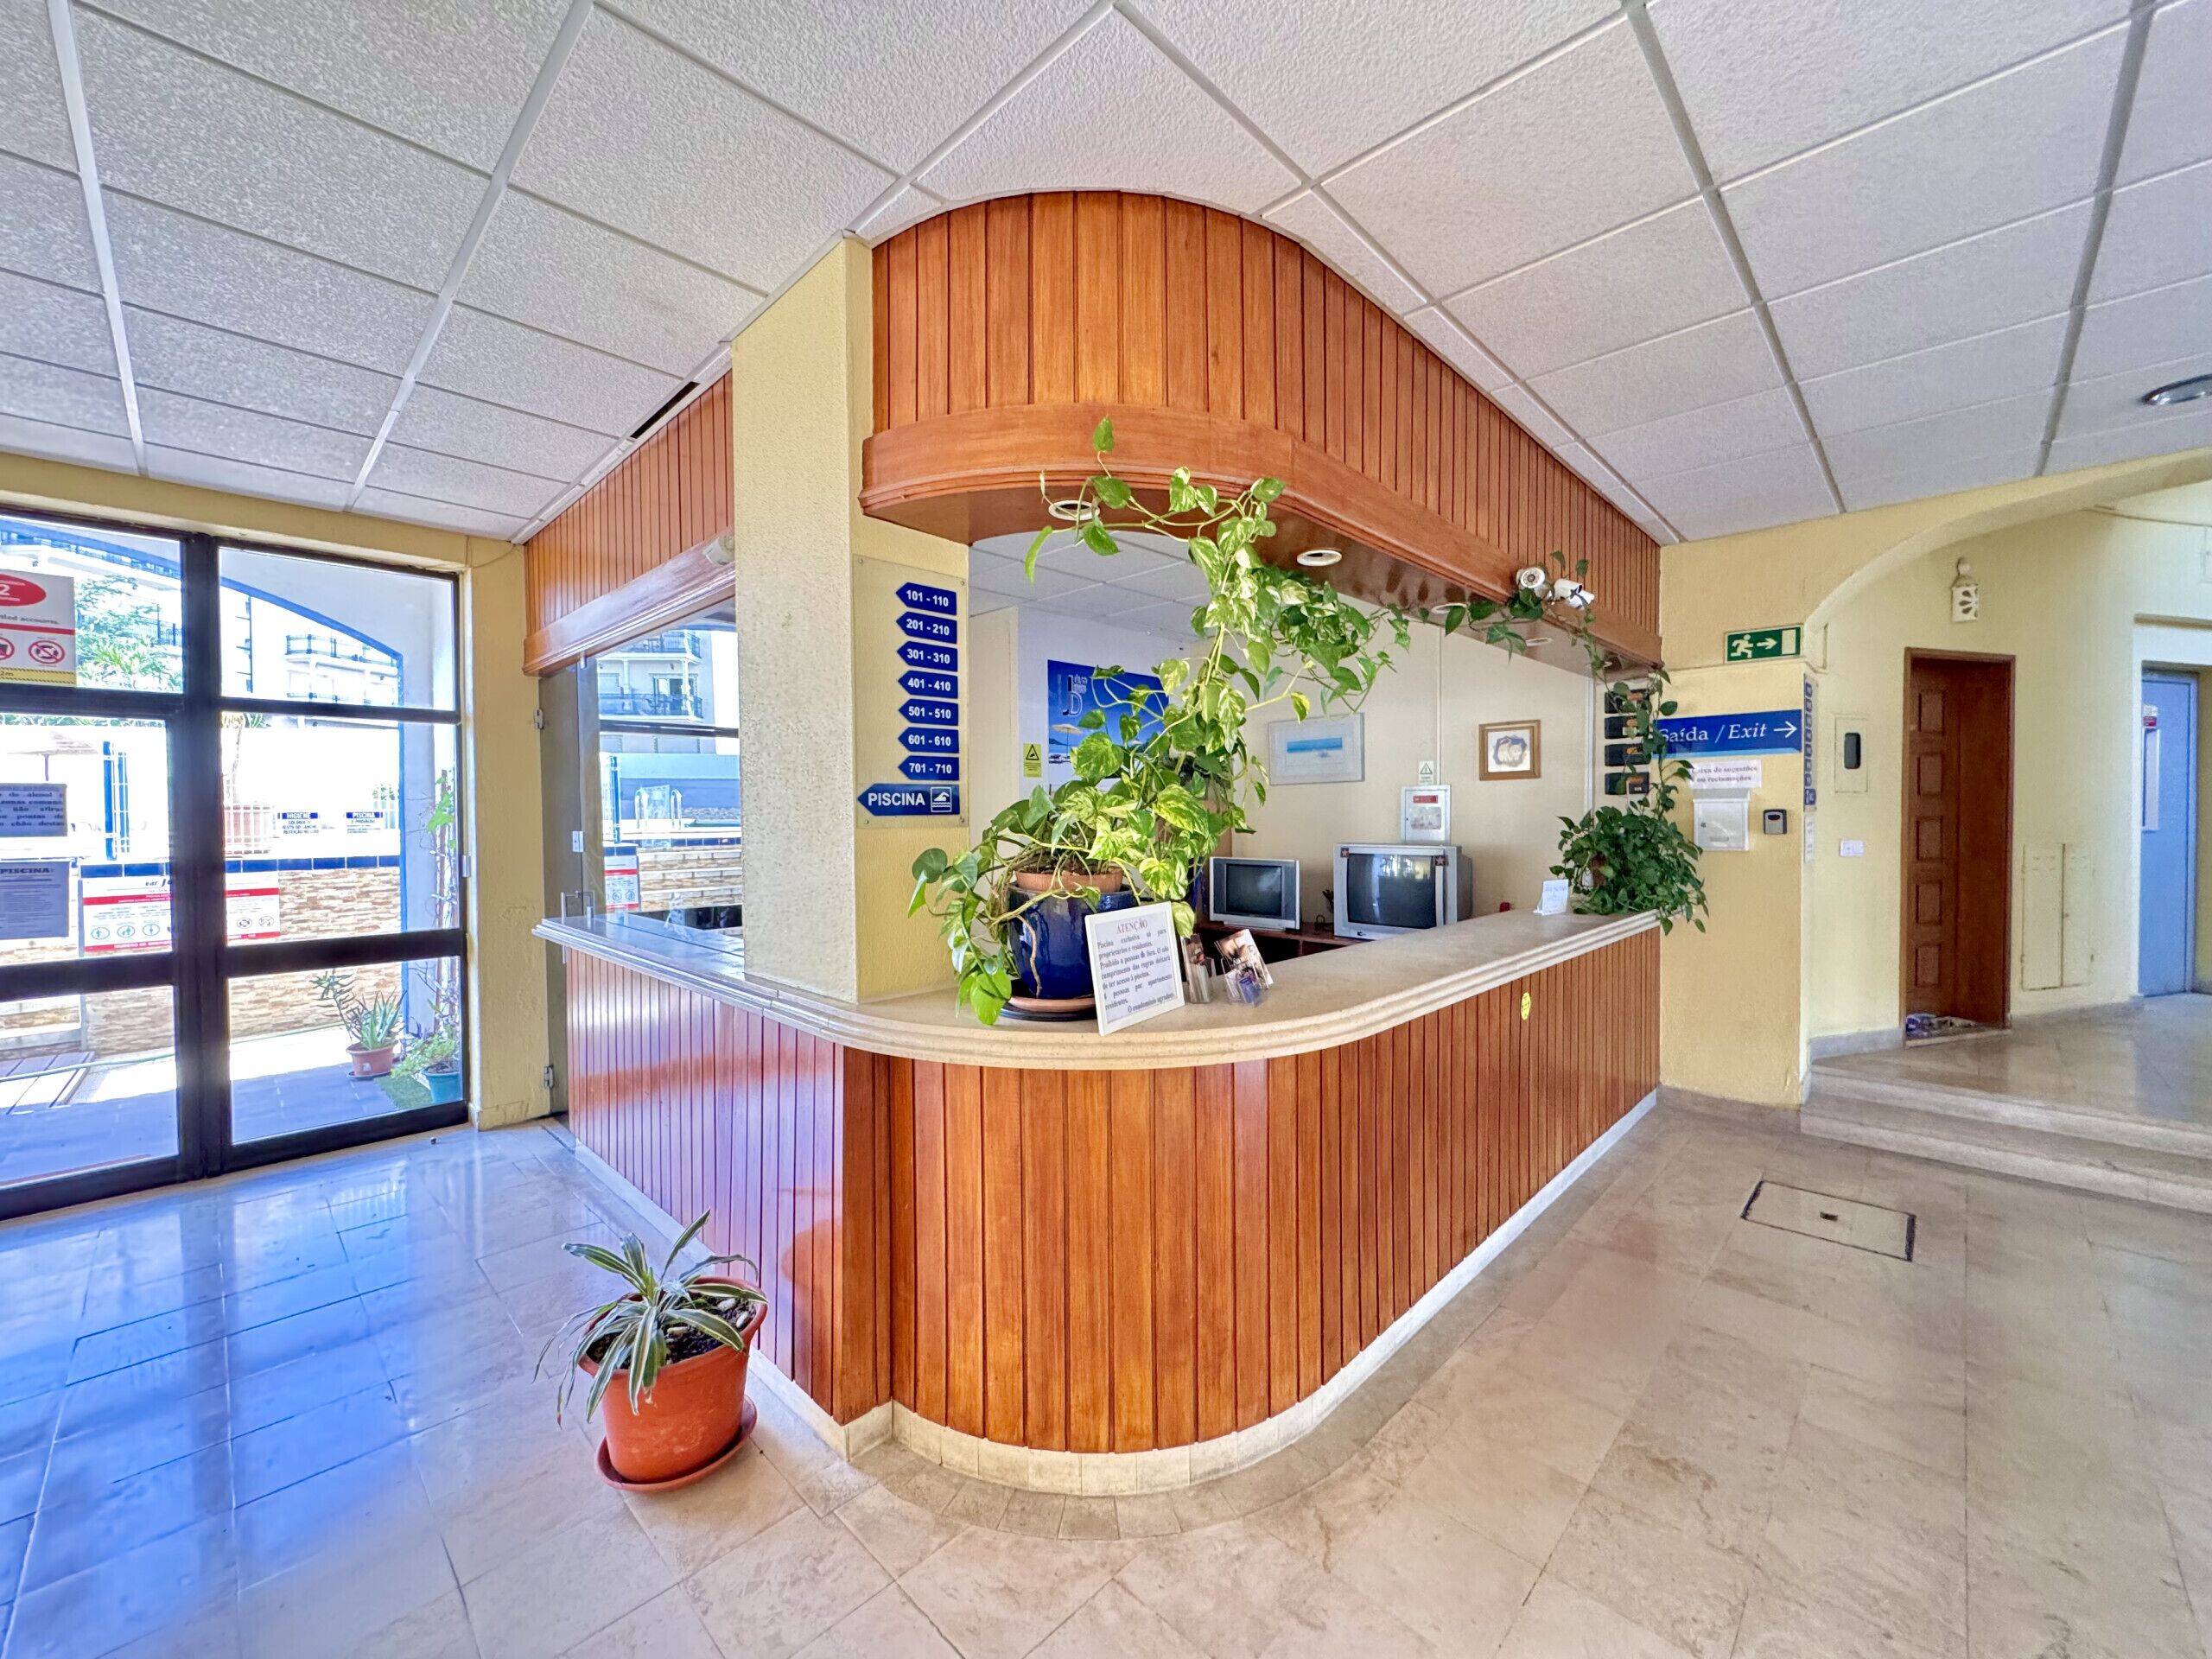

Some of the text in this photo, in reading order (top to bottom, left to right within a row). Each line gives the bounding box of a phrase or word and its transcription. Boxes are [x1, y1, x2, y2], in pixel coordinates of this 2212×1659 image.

[906, 589, 923, 602] 101
[932, 595, 949, 607] 110
[906, 618, 924, 631] 201
[932, 623, 950, 636] 210
[906, 648, 924, 660] 301
[933, 652, 950, 664] 310
[907, 677, 925, 690] 401
[933, 680, 951, 692] 410
[908, 706, 925, 717] 501
[934, 708, 951, 720] 510
[1659, 726, 1709, 743] Saída
[1728, 721, 1768, 740] Exit
[908, 734, 925, 745] 601
[934, 736, 951, 747] 610
[908, 762, 926, 773] 701
[935, 764, 952, 774] 710
[868, 792, 925, 806] PISCINA
[1116, 918, 1148, 934] ATENÇÃO
[1097, 940, 1113, 949] Piscina
[1121, 935, 1140, 944] exclusiva
[1158, 928, 1166, 937] para
[1100, 958, 1119, 969] Proibido
[1124, 954, 1140, 965] pessoas
[1141, 960, 1154, 969] regras
[1116, 977, 1130, 986] acesso
[1113, 987, 1129, 998] pessoas
